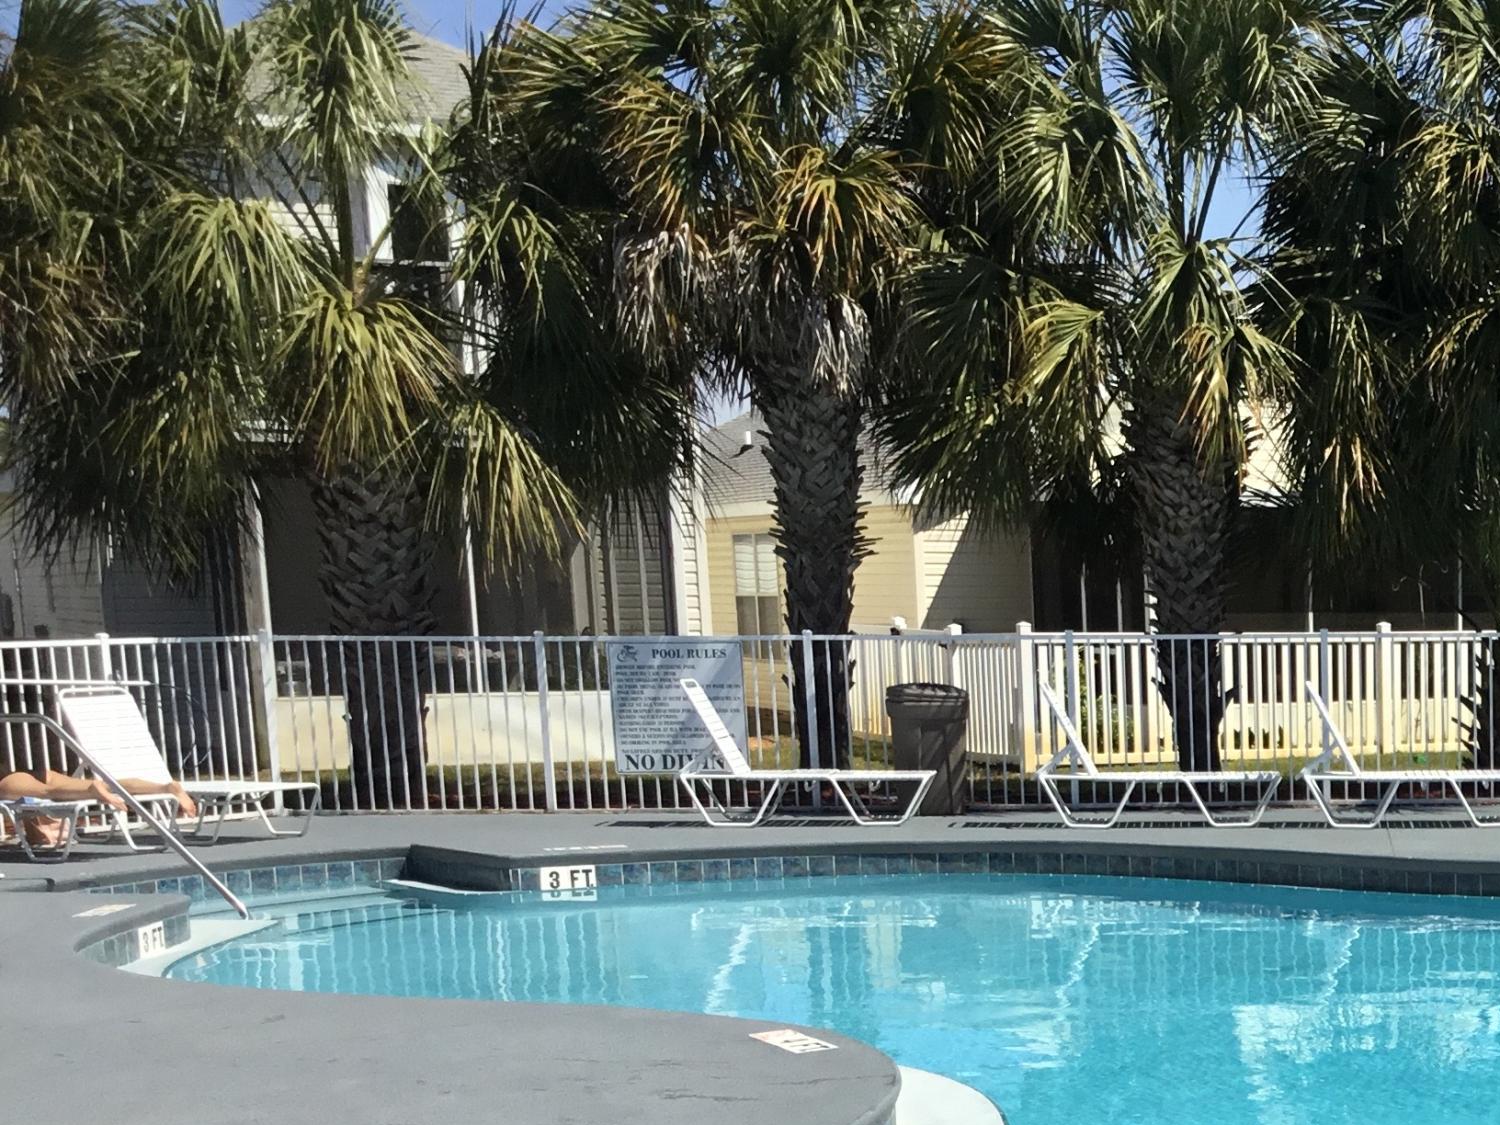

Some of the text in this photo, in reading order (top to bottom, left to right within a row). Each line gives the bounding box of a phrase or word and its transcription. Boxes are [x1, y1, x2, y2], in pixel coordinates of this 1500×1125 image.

[651, 648, 727, 659] POOL RULES
[624, 754, 725, 770] NO DIIN
[549, 870, 560, 889] 3
[142, 931, 149, 953] 3
